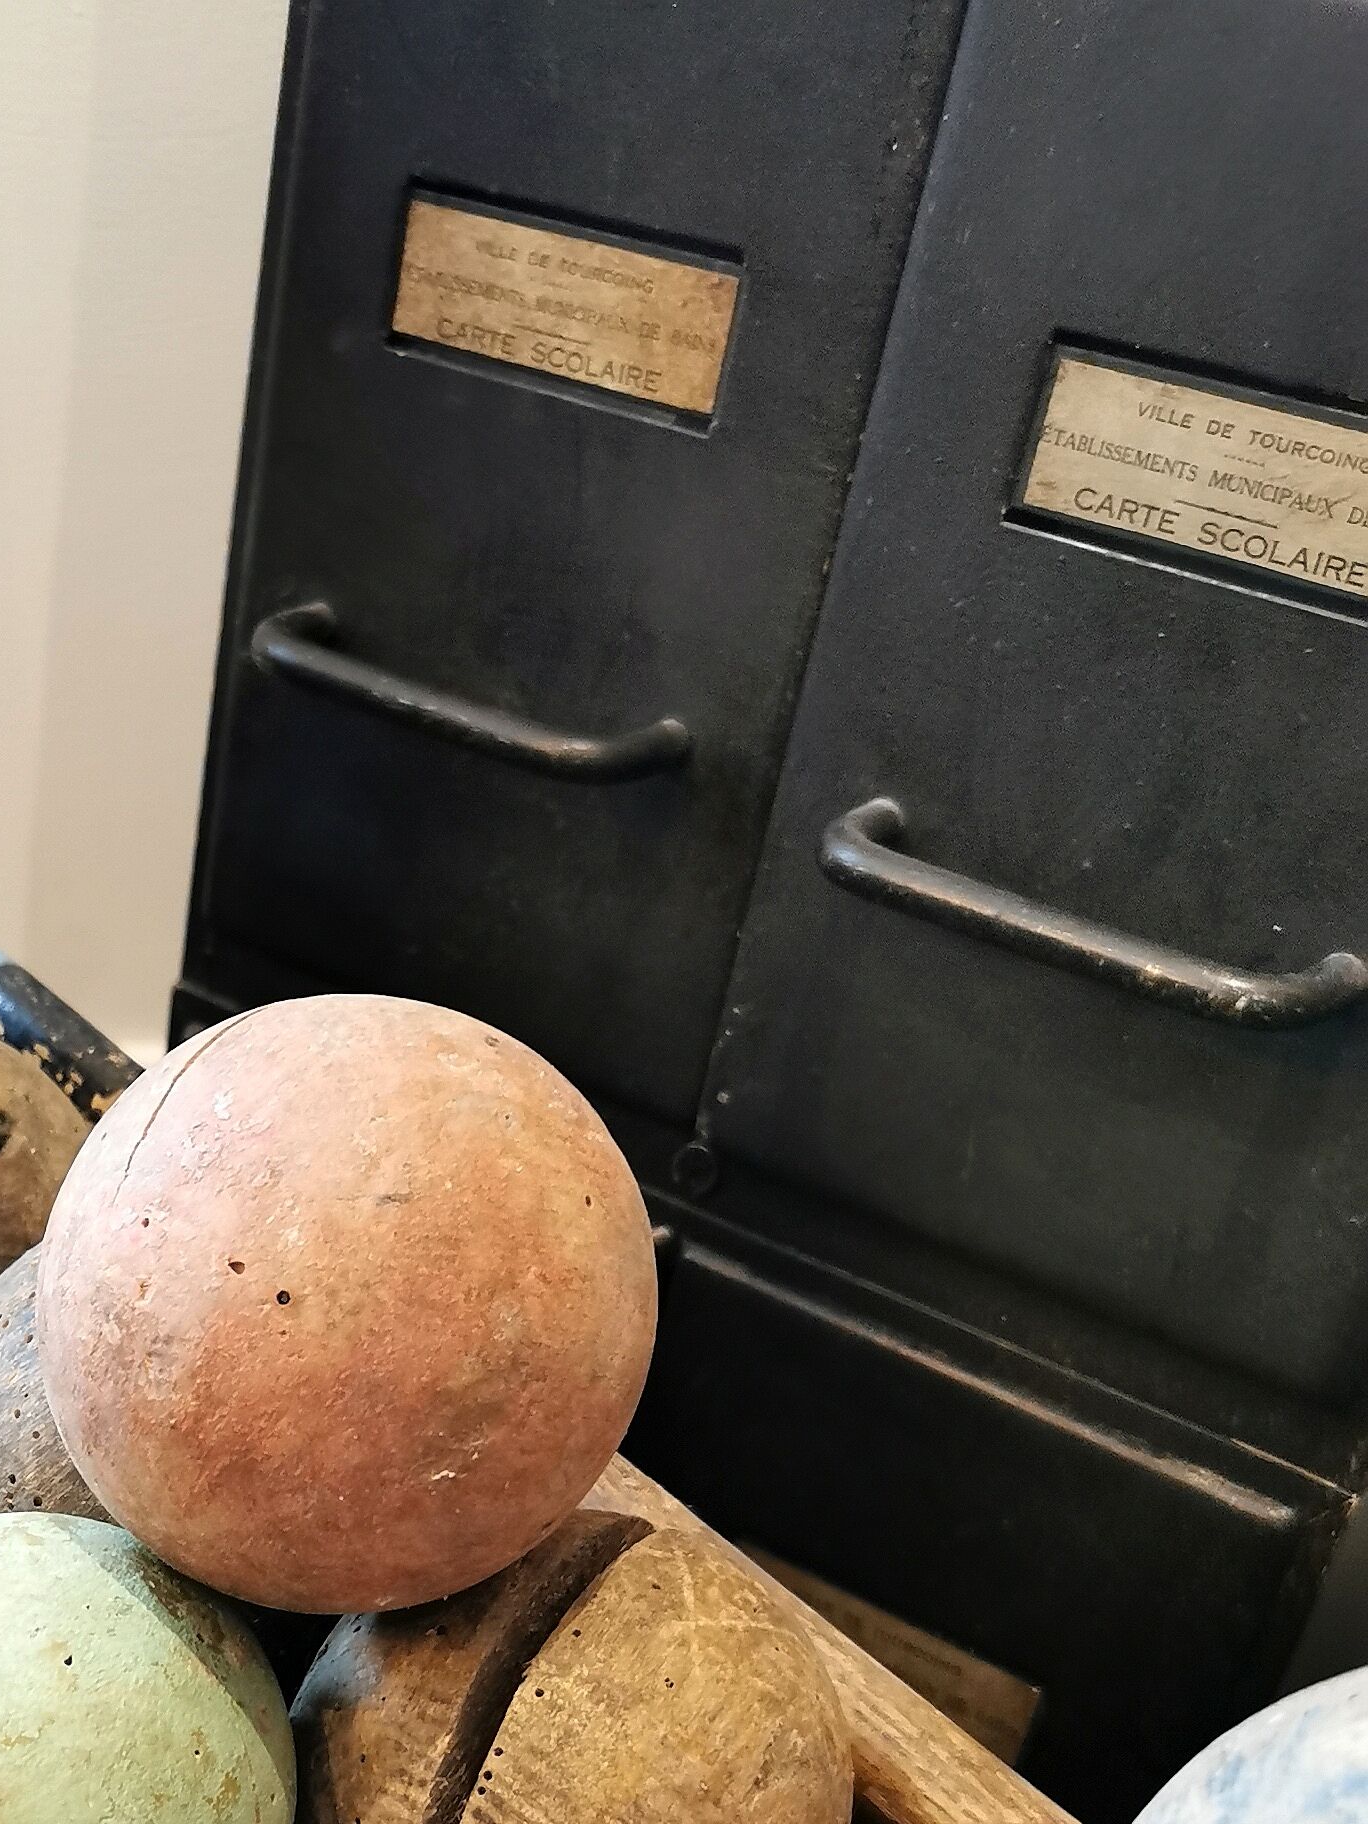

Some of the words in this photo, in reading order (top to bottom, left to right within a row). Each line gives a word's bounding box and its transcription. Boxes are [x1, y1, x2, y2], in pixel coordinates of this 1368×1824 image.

[436, 317, 516, 357] CARTE
[531, 341, 662, 393] SCOLAIRE
[1138, 401, 1195, 430] VILLE
[1205, 419, 1236, 440] DE
[1207, 469, 1334, 519] MUNICIPAUX
[1073, 487, 1181, 536] CARTE
[1197, 521, 1368, 588] SCOLAIRE
